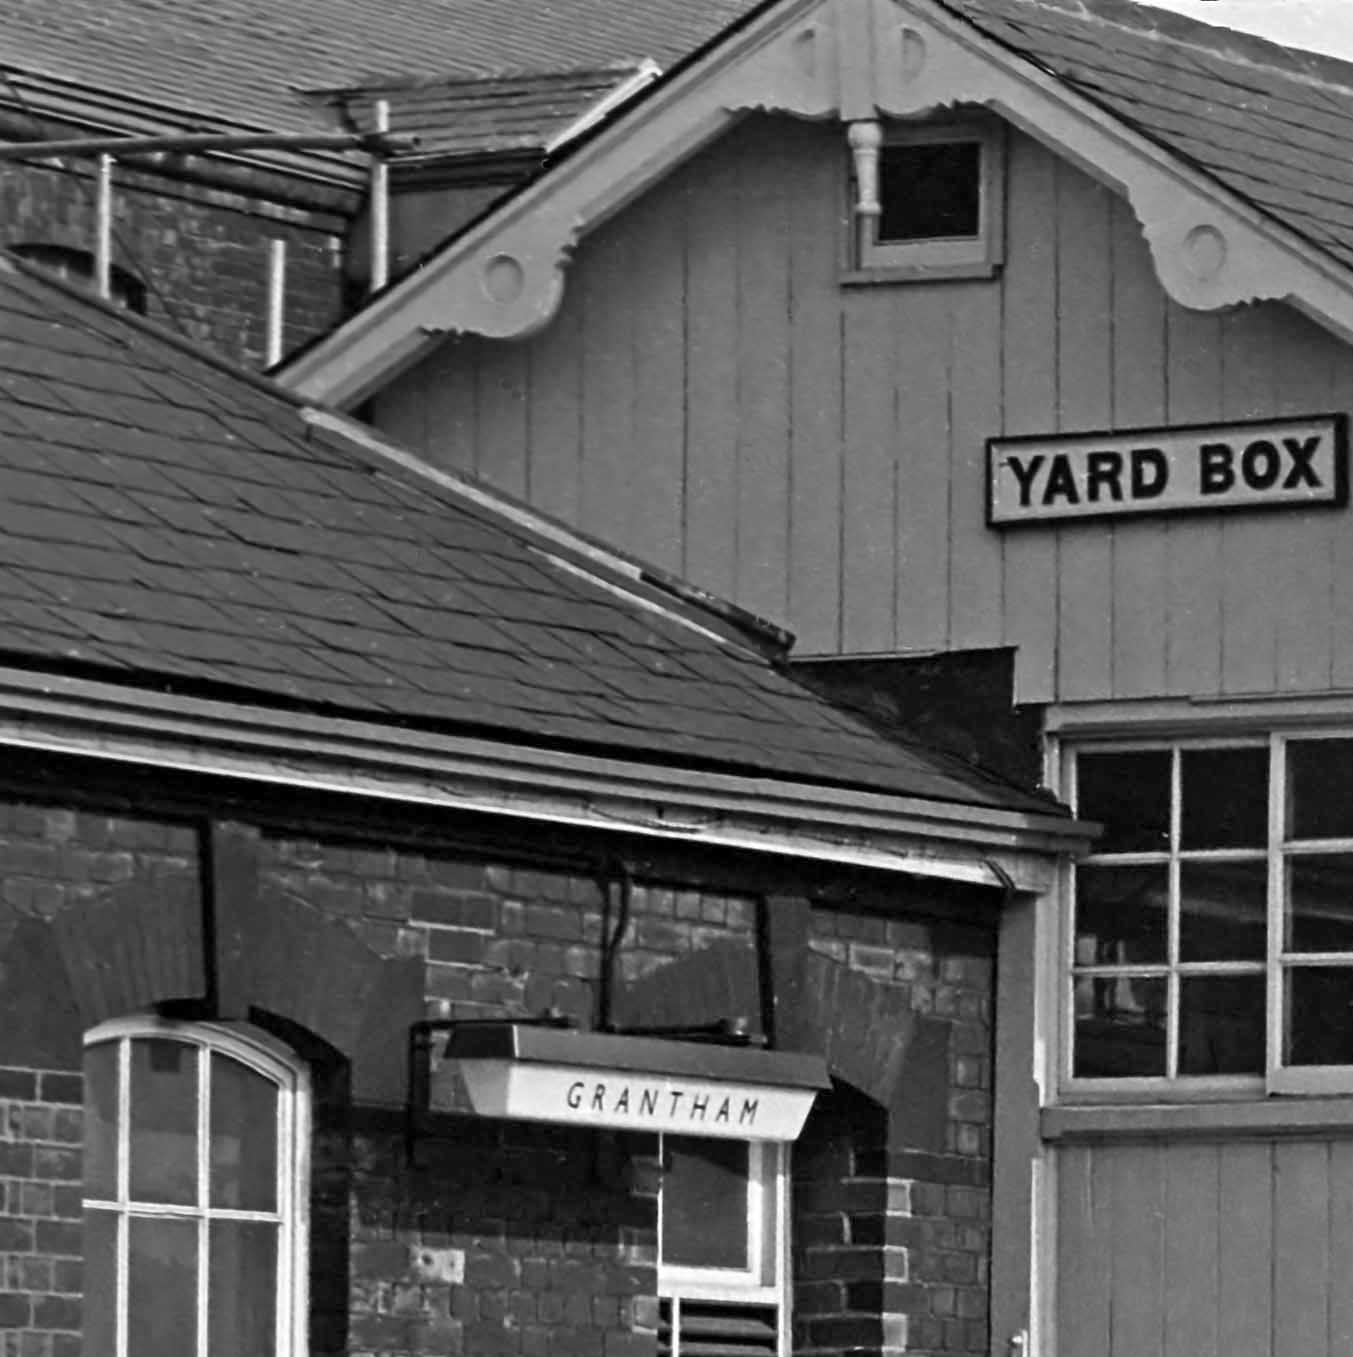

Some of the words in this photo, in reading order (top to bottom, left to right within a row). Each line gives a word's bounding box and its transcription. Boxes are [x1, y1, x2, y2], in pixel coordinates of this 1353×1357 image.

[1006, 447, 1169, 507] YARD
[1199, 435, 1324, 496] BOX
[565, 1081, 760, 1126] GRANTHAM
